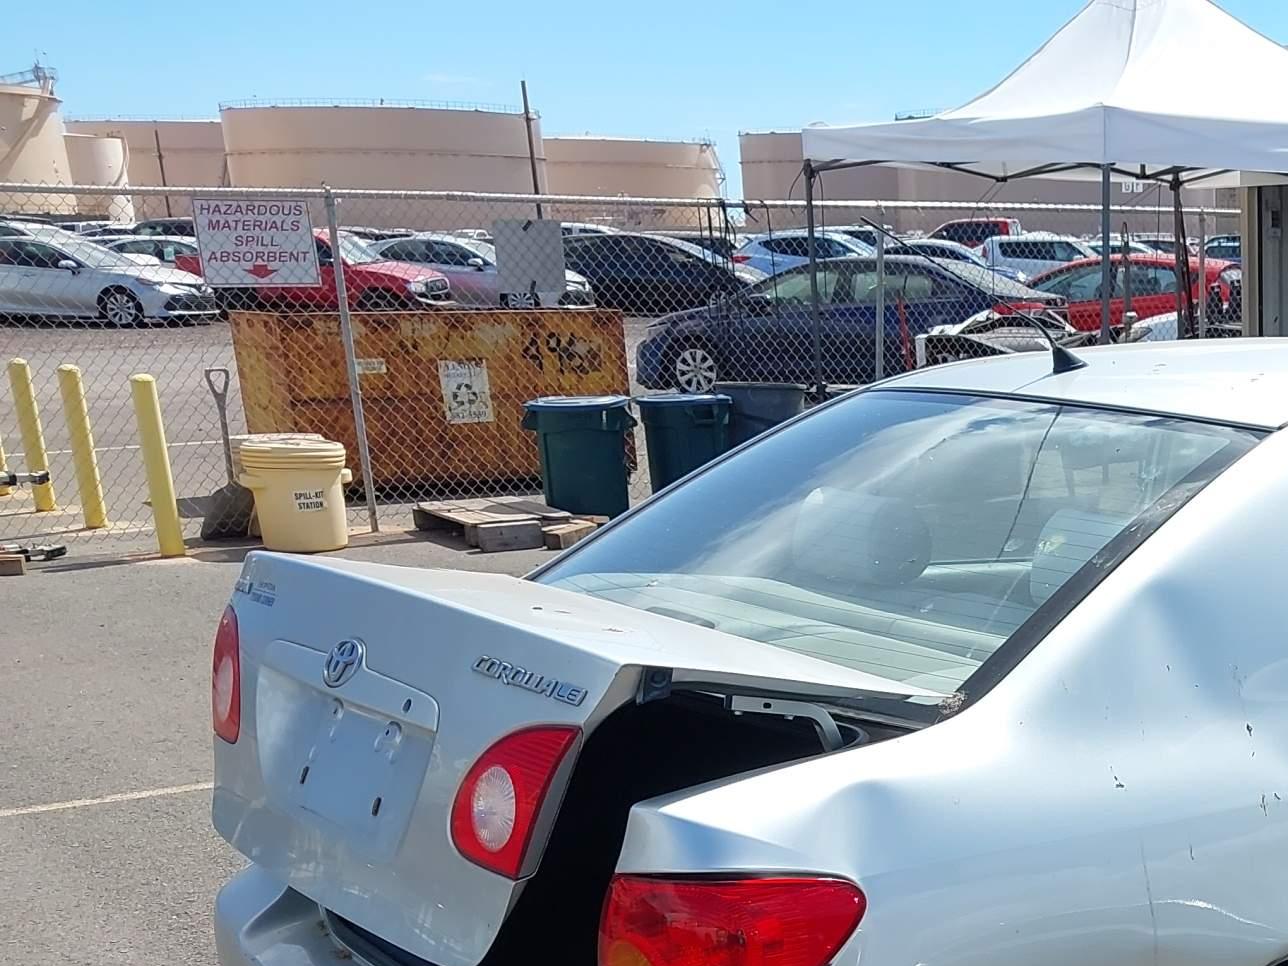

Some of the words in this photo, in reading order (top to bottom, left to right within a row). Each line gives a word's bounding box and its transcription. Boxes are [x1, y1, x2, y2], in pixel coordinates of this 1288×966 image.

[199, 203, 303, 216] HAZARDOUS
[207, 219, 300, 232] MATERIALS
[234, 235, 279, 247] SPILL
[207, 250, 310, 263] ABSORBENT
[294, 490, 324, 500] SPILL-KIT
[297, 500, 324, 510] STATION
[472, 654, 559, 698] COROLLA
